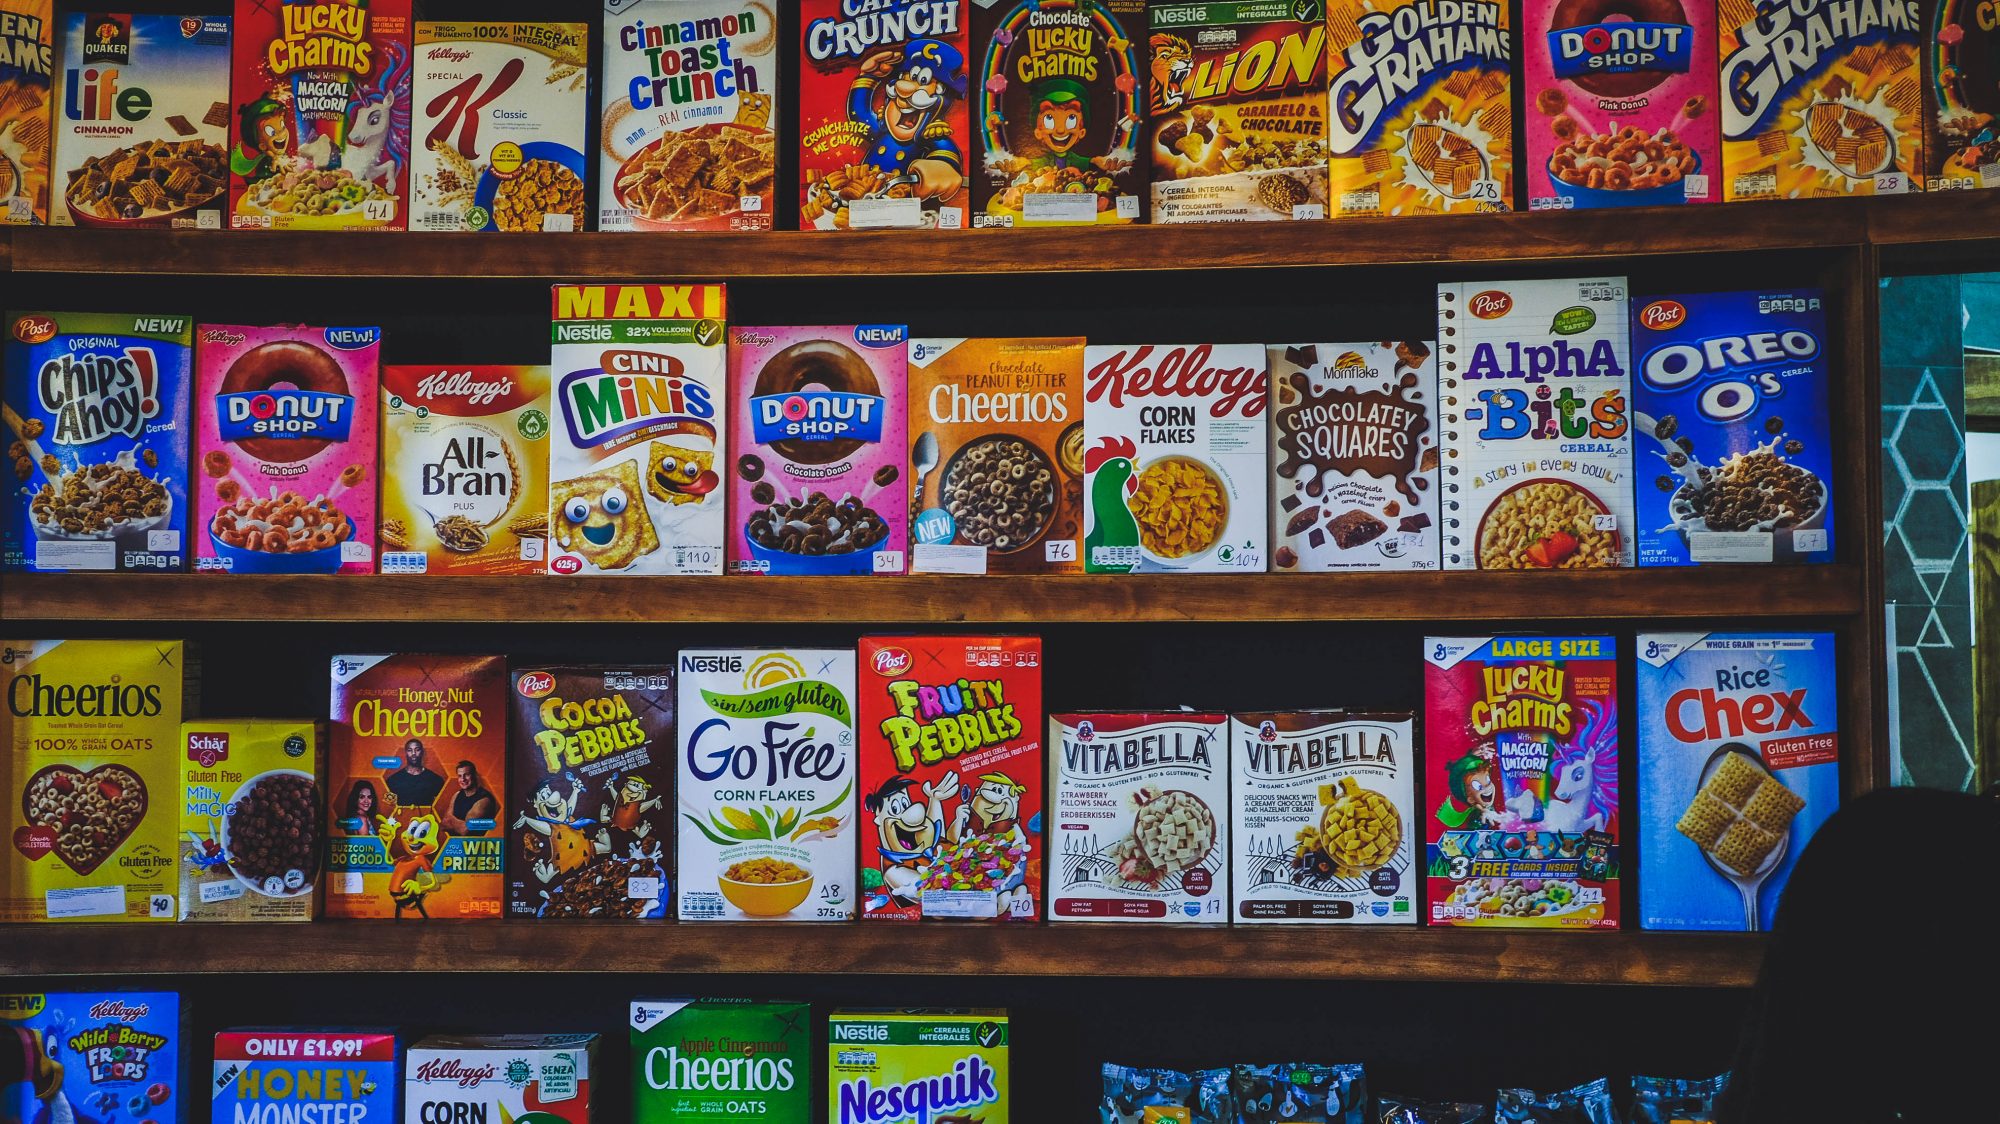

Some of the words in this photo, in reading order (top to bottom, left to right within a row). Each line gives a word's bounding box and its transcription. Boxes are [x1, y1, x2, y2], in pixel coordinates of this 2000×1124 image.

[1236, 9, 1287, 19] INTEGRALES
[1250, 3, 1287, 11] CEREALES
[282, 3, 366, 42] Lucky
[1029, 11, 1090, 28] Chocolate
[434, 31, 472, 39] FRUMENTO
[473, 25, 509, 39] 100%
[513, 24, 578, 47] INTEGRAL
[619, 10, 756, 52] Cinnamon
[809, 0, 960, 61] CRUNCH
[1348, 0, 1499, 67] GOLDEN
[86, 45, 127, 54] QUAKER
[1026, 26, 1092, 58] Lucky
[1561, 27, 1672, 59] DONUT
[269, 37, 372, 75] Charms
[427, 47, 472, 63] Kellogg's
[644, 37, 741, 78] Toast
[1588, 52, 1656, 68] SHOP
[1016, 51, 1098, 84] Charms
[1721, 0, 1920, 138] GRAHAMS
[297, 81, 349, 98] MAGICAL
[628, 58, 758, 111] Crunch
[1329, 24, 1510, 155] GRAHAMS
[66, 69, 153, 122] life
[1599, 100, 1619, 110] Pink
[1620, 97, 1647, 110] Donut
[297, 96, 348, 114] UNICORN
[492, 108, 528, 119] Classic
[1236, 103, 1305, 118] CARAMELO
[74, 126, 133, 135] CINNAMON
[1240, 118, 1323, 136] CHOCOLATE
[1166, 187, 1196, 195] CEREAL
[1198, 185, 1235, 193] INTEGRAL
[1472, 183, 1498, 199] 28
[1877, 177, 1898, 191] 28
[368, 201, 391, 219] 41
[557, 286, 722, 318] MAXI
[1475, 296, 1506, 313] Post
[1647, 305, 1679, 327] Post
[19, 318, 51, 337] Post
[134, 318, 184, 334] NEW!
[626, 326, 650, 337] 32%
[651, 326, 692, 334] VOLLKORN
[69, 336, 121, 352] ORIGINAL
[611, 355, 670, 375] CINI
[1645, 330, 1817, 385] OREO
[966, 374, 1010, 390] PEANUT
[1016, 372, 1067, 389] BUTTER
[1323, 365, 1379, 380] Mornflake
[1781, 367, 1813, 379] CEREAL
[41, 352, 137, 413] Chips
[416, 370, 518, 405] Kellogg's
[228, 394, 345, 422] DONUT
[761, 395, 876, 425] DONUT
[928, 381, 1069, 425] Cheerios
[1139, 406, 1196, 427] CORN
[1287, 401, 1418, 432] CHOCOLATEY
[146, 421, 177, 434] Cereal
[252, 420, 318, 434] SHOP
[785, 421, 850, 435] SHOP
[1140, 428, 1196, 445] FLAKES
[1296, 424, 1409, 461] SQUARES
[1559, 443, 1616, 455] CEREAL
[261, 465, 280, 475] Pink
[281, 464, 308, 475] Donut
[783, 462, 824, 478] Chocolate
[826, 462, 853, 477] Donut
[422, 462, 507, 496] Bran
[453, 502, 475, 511] PLUS
[916, 516, 951, 538] NEW
[1597, 515, 1614, 529] 71
[525, 543, 538, 559] 5
[1049, 544, 1070, 559] 76
[876, 554, 895, 567] 34
[1491, 640, 1554, 658] LARGE
[1559, 640, 1601, 657] SIZE
[1705, 640, 1730, 648] WHOLE
[1732, 640, 1755, 648] GRAIN
[1482, 664, 1565, 704] Lucky
[1716, 665, 1771, 692] Rice
[7, 673, 163, 718] Cheerios
[398, 687, 443, 705] Honey
[447, 687, 475, 704] Nut
[352, 698, 484, 738] Cheerios
[539, 693, 633, 731] COCOA
[1471, 699, 1573, 736] Charms
[1664, 687, 1816, 744] Chex
[34, 738, 78, 752] 100%
[110, 738, 153, 752] OATS
[190, 734, 227, 754] Schär
[533, 717, 648, 774] PEBBLES
[881, 703, 1022, 772] PEBBLES
[1767, 741, 1807, 755] Gluten
[1808, 738, 1833, 750] Free
[687, 717, 758, 782] Go
[761, 720, 847, 787] Free
[1062, 731, 1212, 775] VITABELLA
[1244, 731, 1397, 775] VITABELLA
[1501, 741, 1549, 757] MAGICAL
[1501, 755, 1549, 772] UNICORN
[187, 770, 218, 783] Gluten
[221, 770, 242, 783] Free
[713, 789, 755, 801] CORN
[759, 789, 815, 801] FLAKES
[1060, 791, 1109, 799] STRAWBERRY
[1060, 799, 1091, 807] PILLOWS
[187, 802, 237, 817] MAGIC
[1060, 811, 1117, 819] ERDBEERKISSEN
[462, 840, 501, 857] WIN
[118, 855, 151, 869] Gluten
[153, 856, 173, 868] Free
[331, 853, 348, 865] DO
[350, 853, 383, 866] GOOD
[442, 855, 500, 872] PRIZES!
[1449, 856, 1469, 879] 3
[1471, 861, 1510, 877] FREE
[1511, 863, 1543, 872] CARDS
[1544, 862, 1578, 872] INSIDE!
[152, 897, 169, 913] 40
[1012, 900, 1031, 913] 70
[70, 1030, 109, 1052] Wild
[118, 1027, 166, 1050] Berry
[919, 1033, 971, 1042] INTEGRALES
[933, 1027, 971, 1035] CEREALES
[245, 1037, 299, 1056] ONLY
[303, 1038, 363, 1057] £1.99!
[680, 1037, 714, 1056] Apple
[717, 1037, 788, 1053] Cinnamon
[88, 1045, 148, 1067] FROOT
[92, 1062, 147, 1082] LOOPS
[215, 1063, 240, 1089] NEW
[416, 1057, 497, 1088] Kellogg's
[540, 1064, 574, 1076] SENZA
[644, 1046, 795, 1092] Cheerios
[237, 1067, 368, 1101] HONEY
[841, 1056, 995, 1124] Nesquik
[233, 1102, 369, 1124] MONSTER
[420, 1101, 488, 1124] CORN
[725, 1100, 767, 1114] OATS
